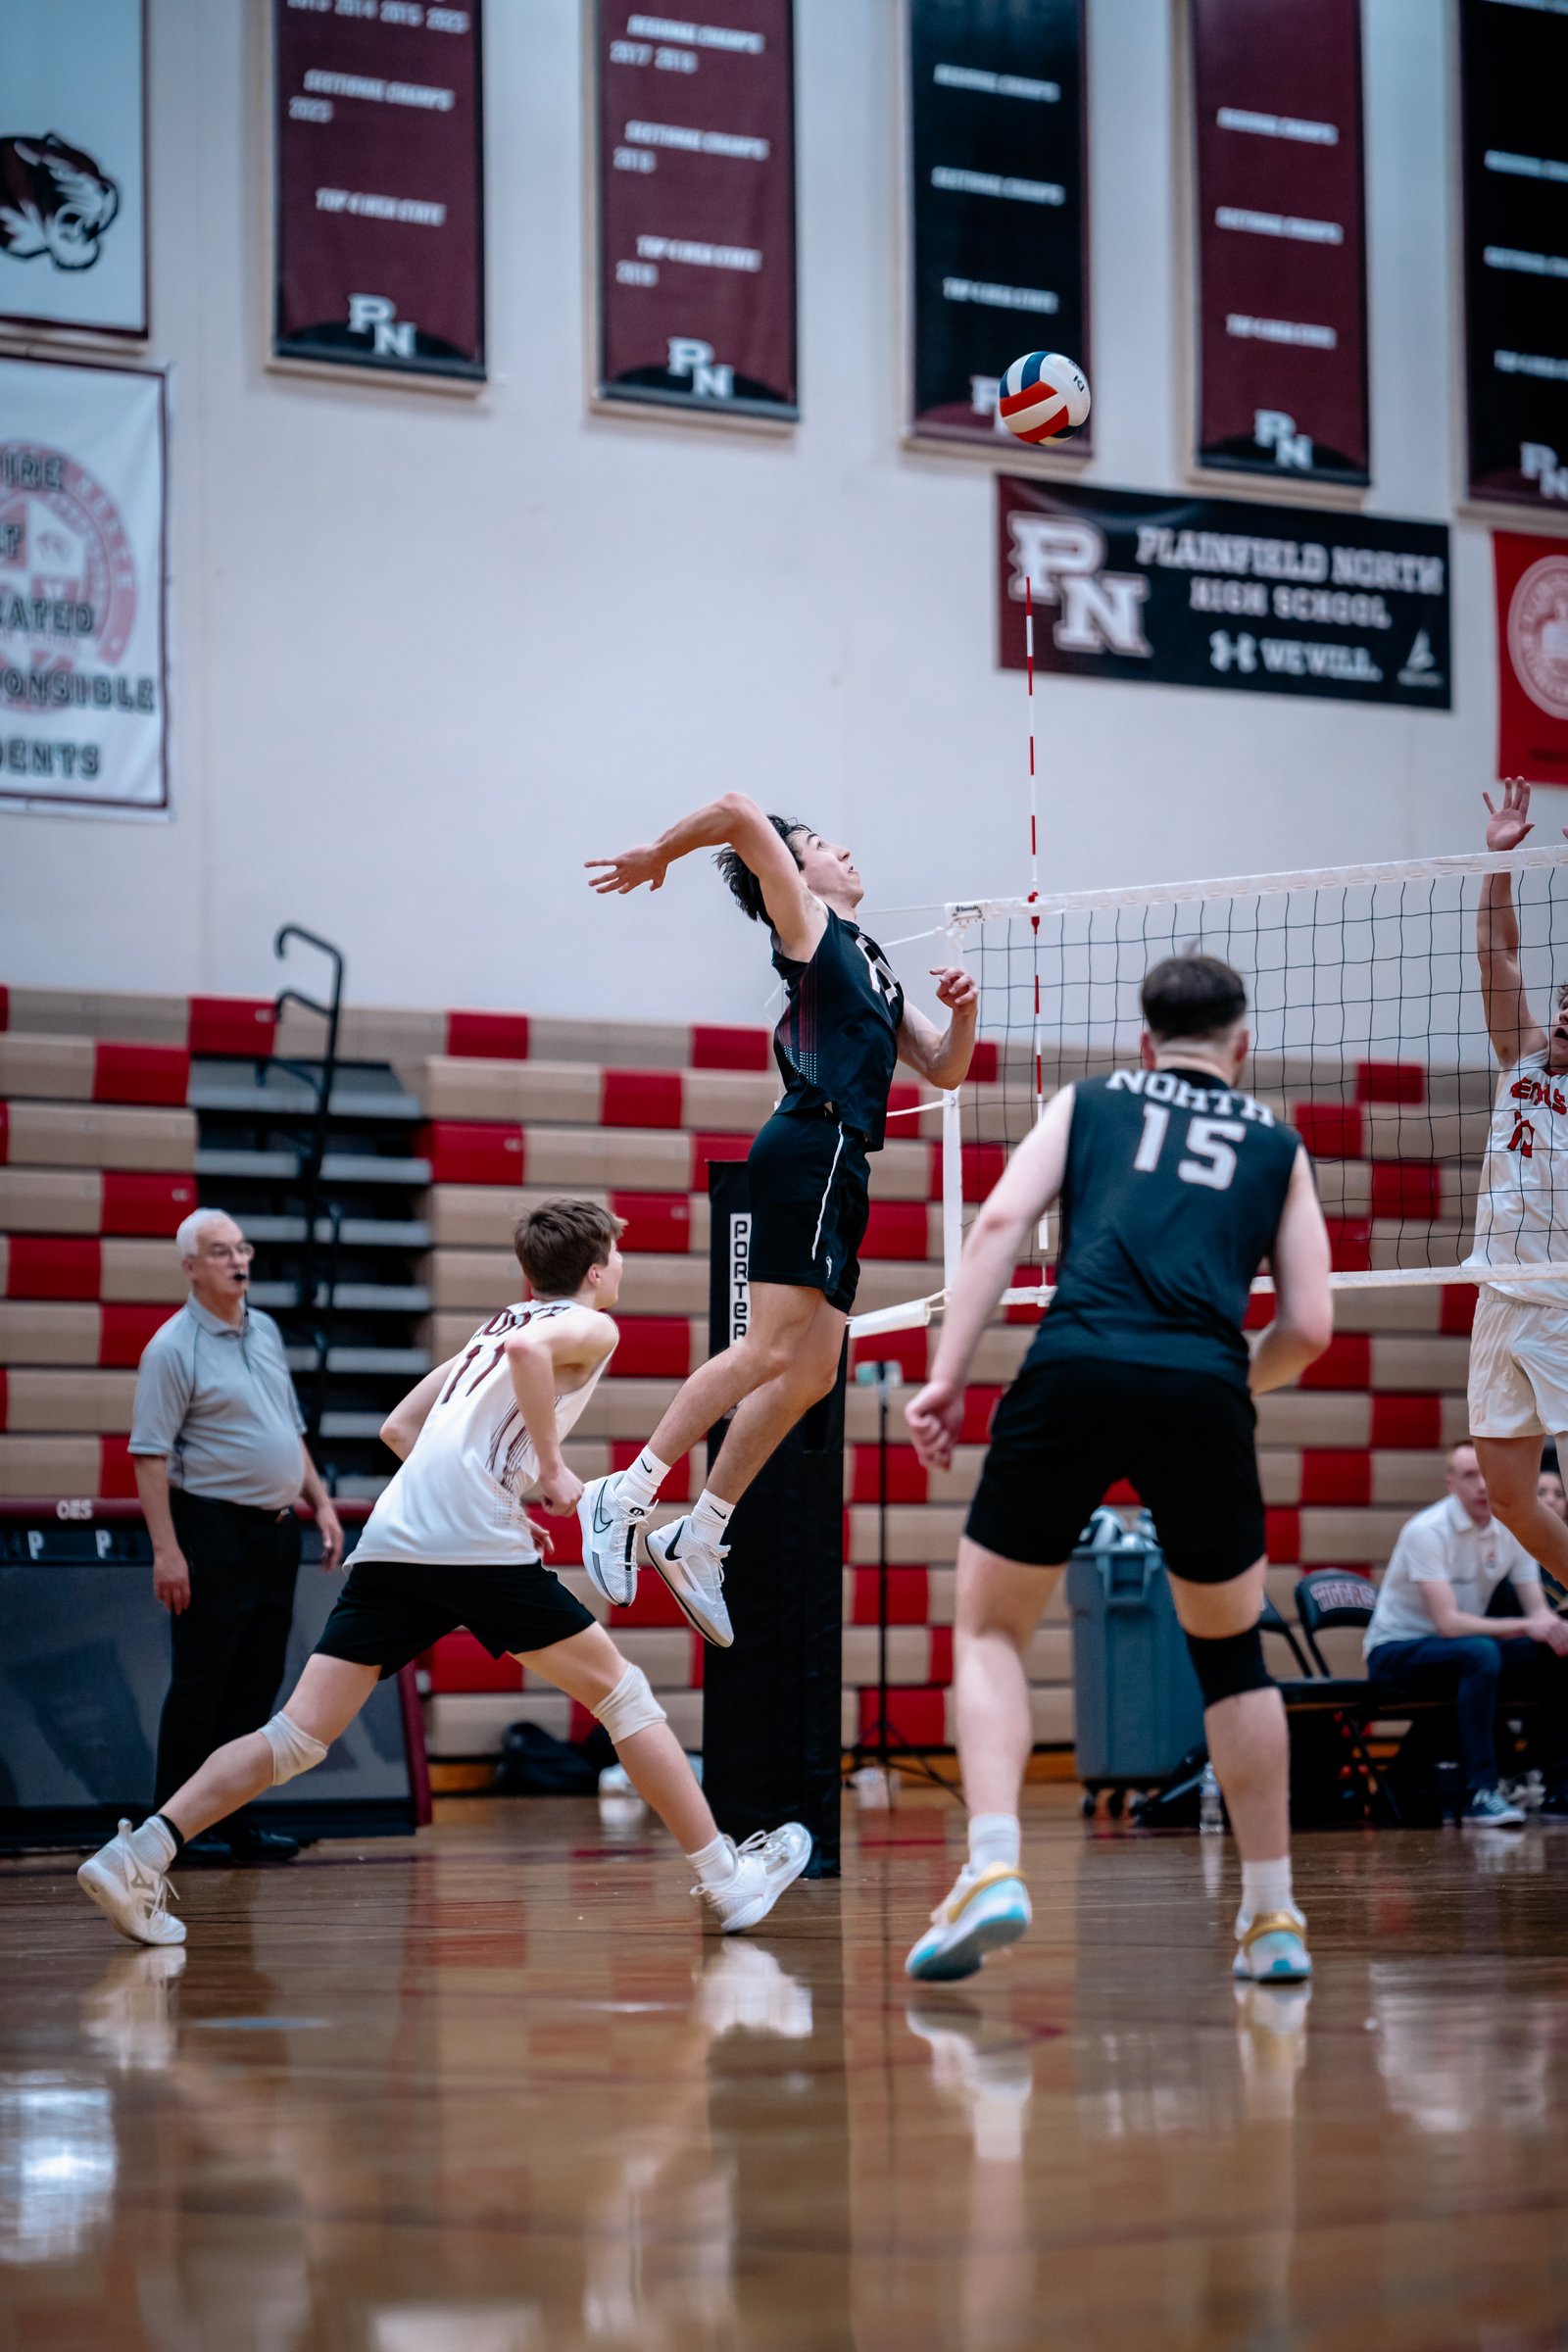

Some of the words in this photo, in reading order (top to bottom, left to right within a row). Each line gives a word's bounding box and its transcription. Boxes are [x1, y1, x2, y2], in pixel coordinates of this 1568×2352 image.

[0, 452, 64, 494] IRE
[1006, 510, 1154, 659] PN
[1135, 524, 1329, 583] PLAINFIELD
[1331, 546, 1445, 596] NORTH
[0, 596, 95, 638] ATED
[1189, 575, 1269, 617] HIGH
[1273, 585, 1393, 630] SCHOOL
[1259, 637, 1305, 676] WE
[0, 737, 102, 781] ENTS
[1134, 1101, 1247, 1192] 15
[441, 1341, 506, 1404] 11
